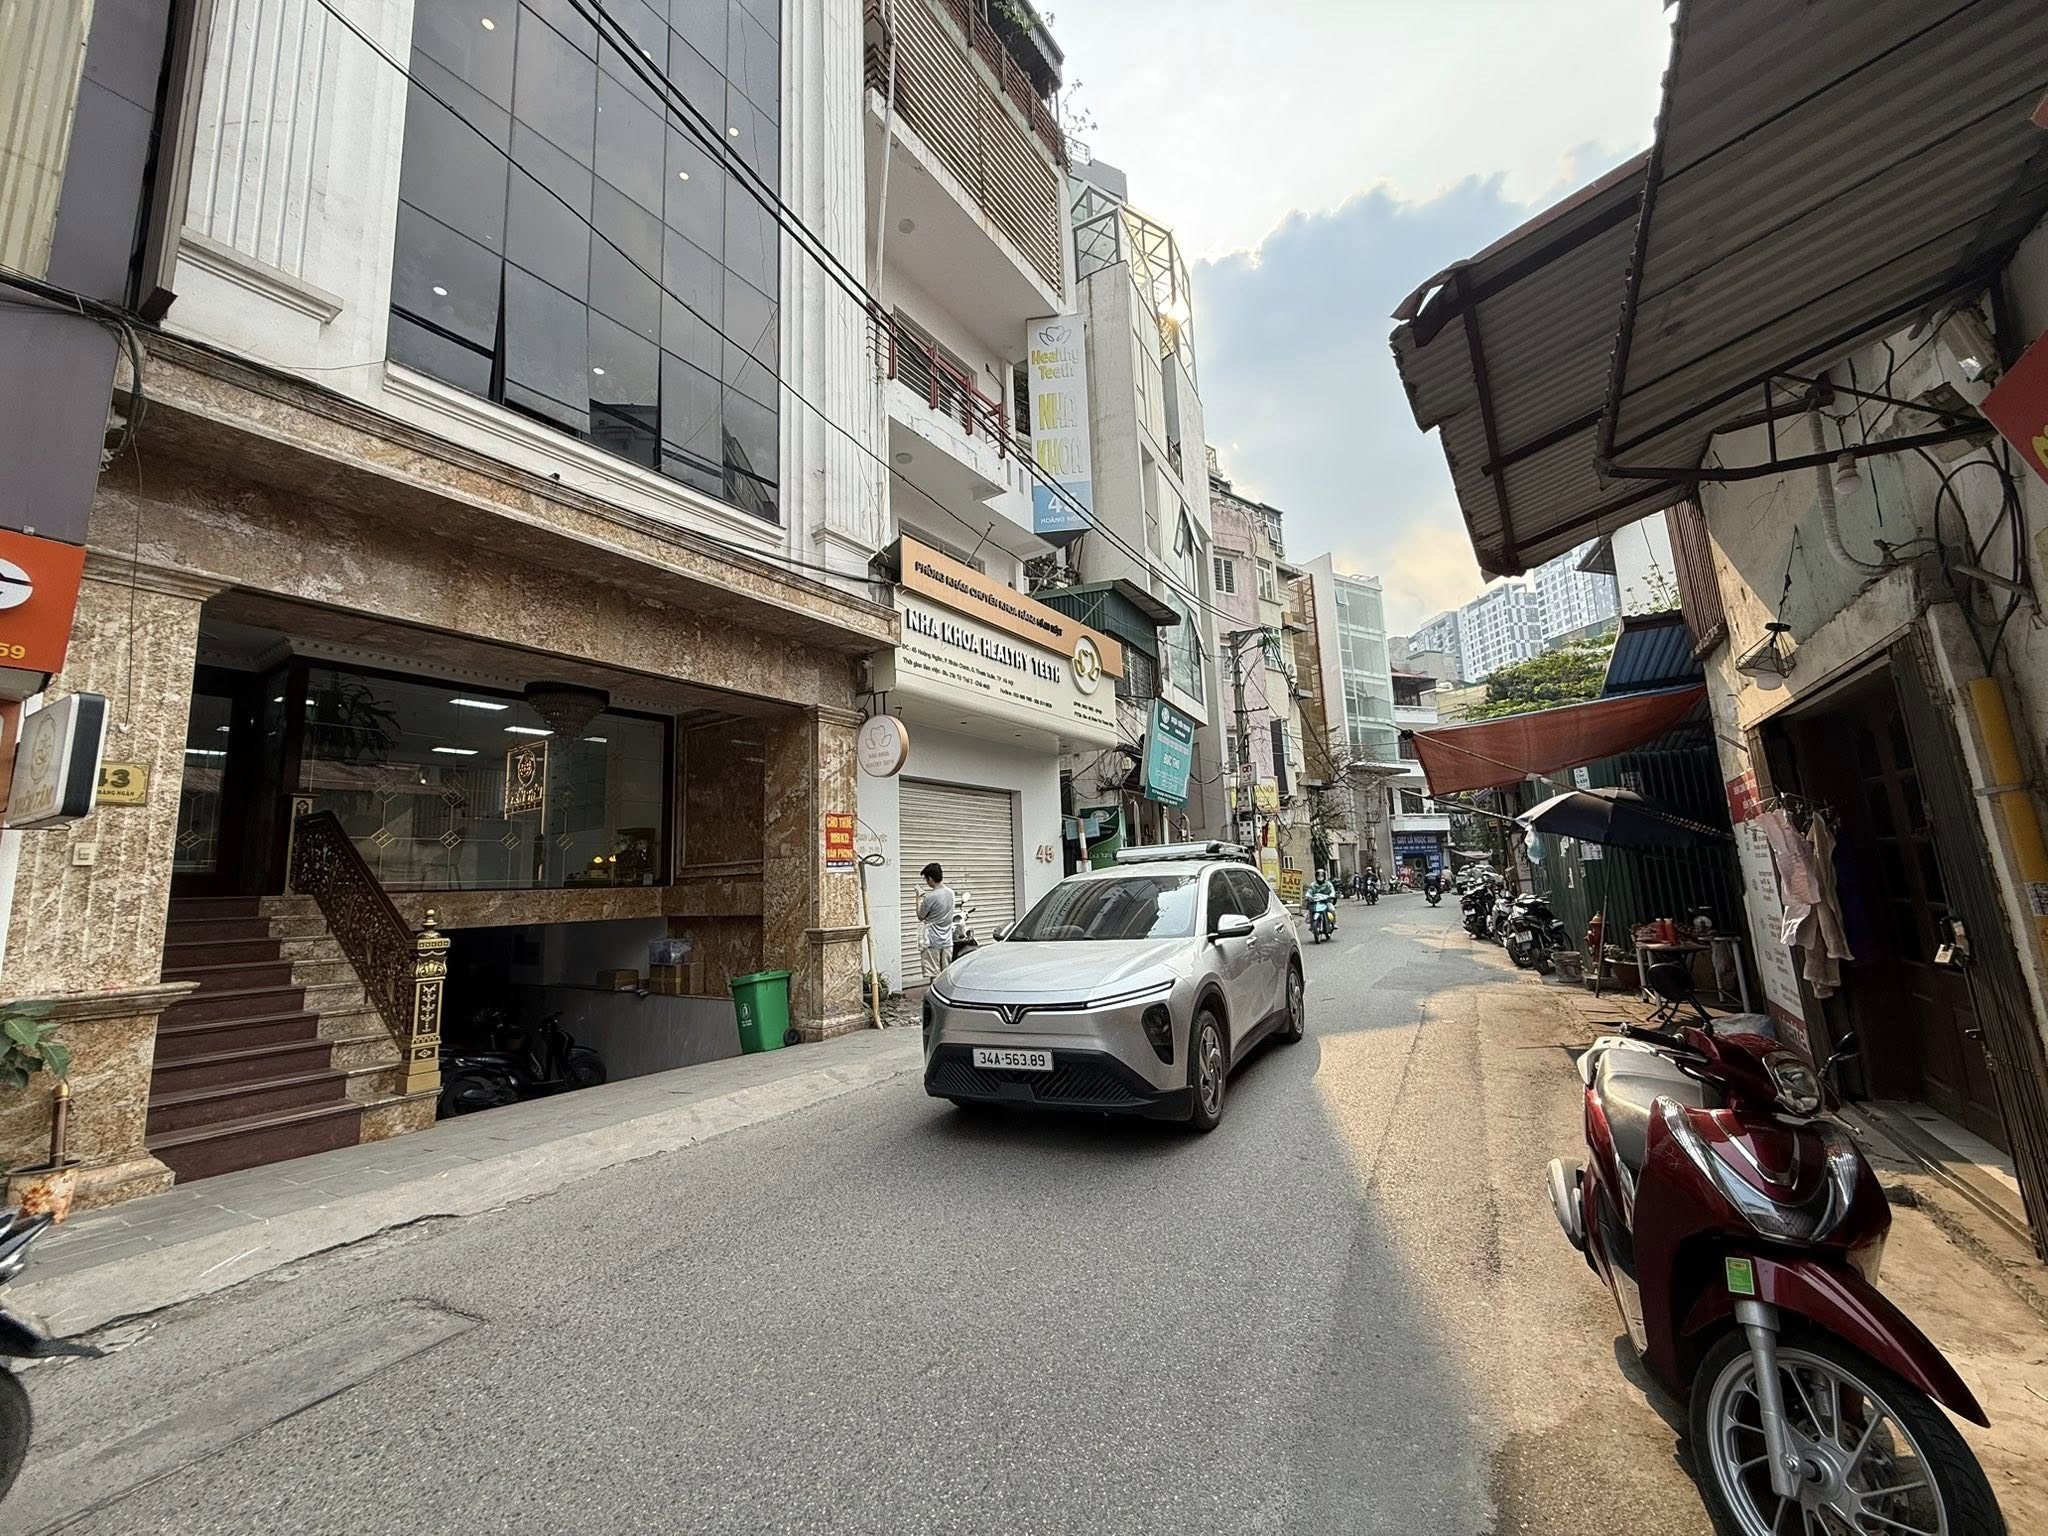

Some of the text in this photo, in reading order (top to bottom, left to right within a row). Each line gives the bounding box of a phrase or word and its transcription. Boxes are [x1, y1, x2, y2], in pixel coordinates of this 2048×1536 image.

[1031, 347, 1079, 365] Healthy
[1038, 363, 1074, 380] Teeth
[1038, 392, 1078, 431] NHA
[1037, 438, 1083, 476] KHOA
[914, 561, 945, 583] PHÒNG
[906, 608, 1061, 684] NHA KHOA HEALTHY TEETH
[1035, 844, 1055, 864] 45
[979, 1052, 1046, 1067] 34A-563.89
